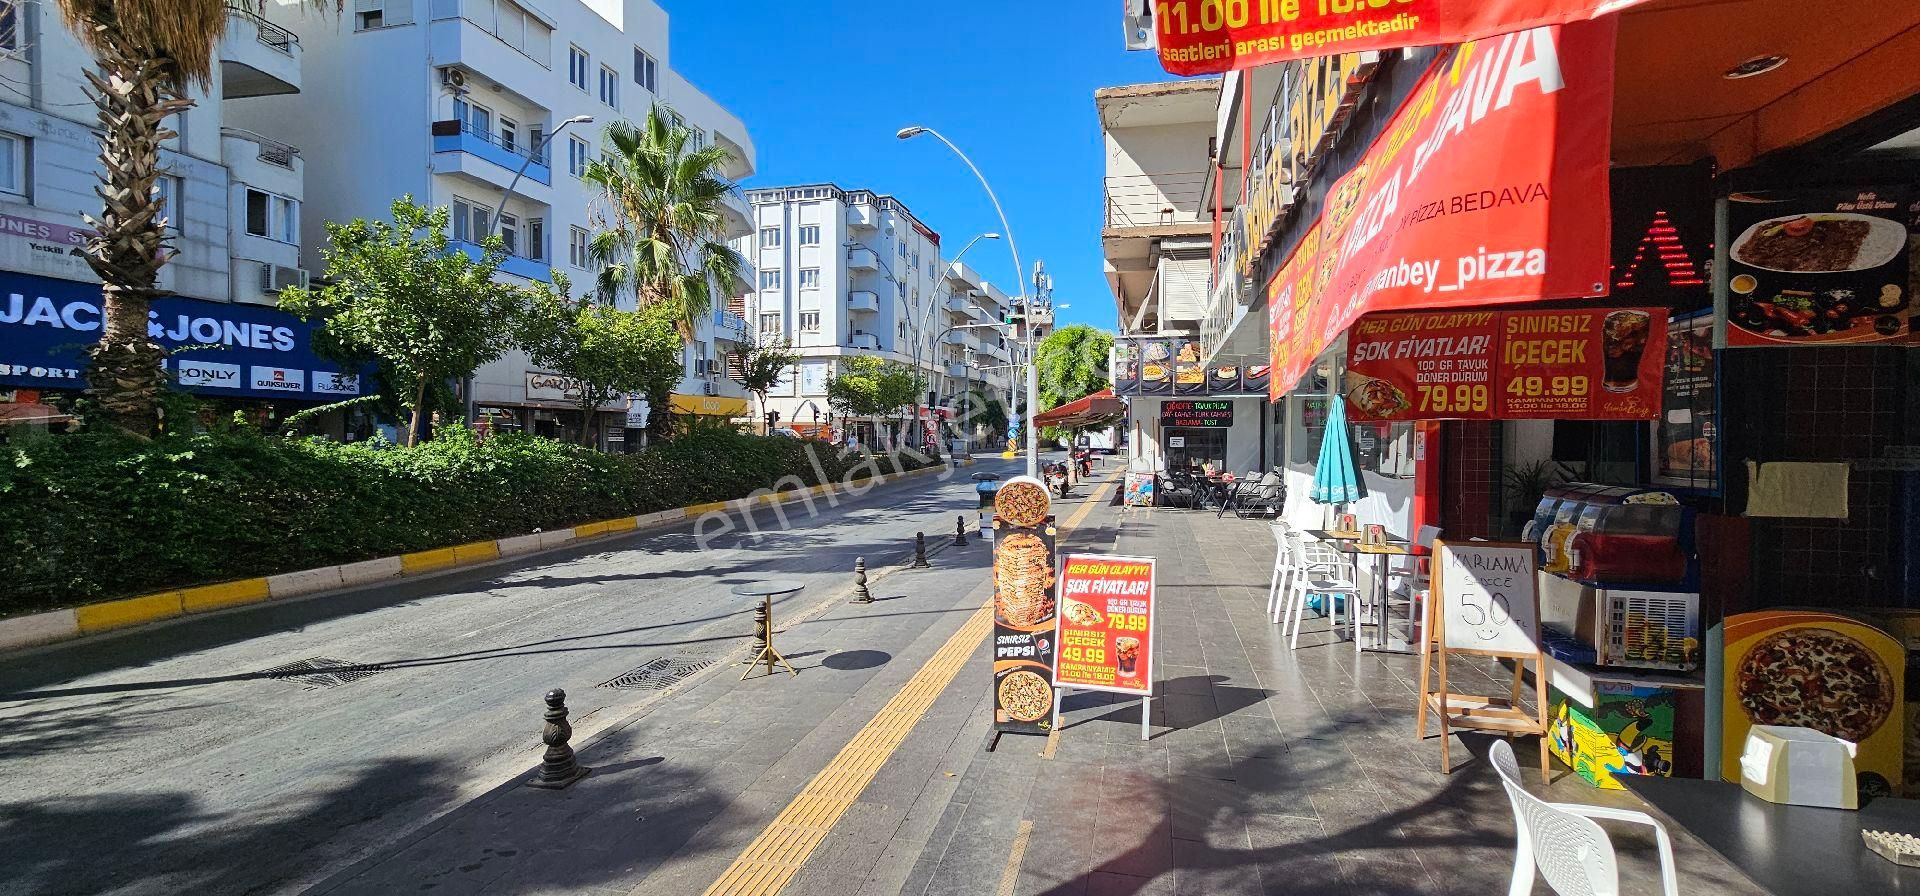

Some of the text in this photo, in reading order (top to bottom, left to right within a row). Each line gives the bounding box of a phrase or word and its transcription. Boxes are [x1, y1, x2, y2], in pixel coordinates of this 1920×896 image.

[1157, 0, 1249, 35] 11.00
[1163, 14, 1419, 63] saatleri arası geçmektedir
[1450, 182, 1550, 215] BEDAVA
[29, 243, 64, 254] Yetkili
[0, 293, 107, 332] JAC
[166, 314, 296, 352] JONES
[1356, 312, 1494, 335] HER GÜN OLAYYY!
[1506, 315, 1592, 334] SINIRSIZ
[1353, 334, 1491, 366] ŞOK FİYATLAR!
[1504, 334, 1586, 371] İÇECEK
[0, 363, 79, 378] SPORT
[187, 368, 236, 380] ONLY
[1417, 359, 1488, 371] 100 GR TAVUK
[257, 380, 301, 390] QUIKSILVER
[1416, 370, 1488, 383] DÖNER DÜRÜM
[1507, 376, 1589, 397] 49.99
[1417, 385, 1489, 412] 79.99
[1068, 564, 1087, 574] HER
[1088, 563, 1109, 575] GÜN
[1452, 552, 1528, 574] KARLAMA
[1066, 577, 1149, 596] ŞOK FİYATLAR!
[1461, 592, 1510, 627] 50
[1107, 614, 1147, 631] 79.99
[1063, 629, 1106, 638] SINIRSIZ
[997, 645, 1035, 658] PEPSI
[1062, 647, 1105, 663] 49.99
